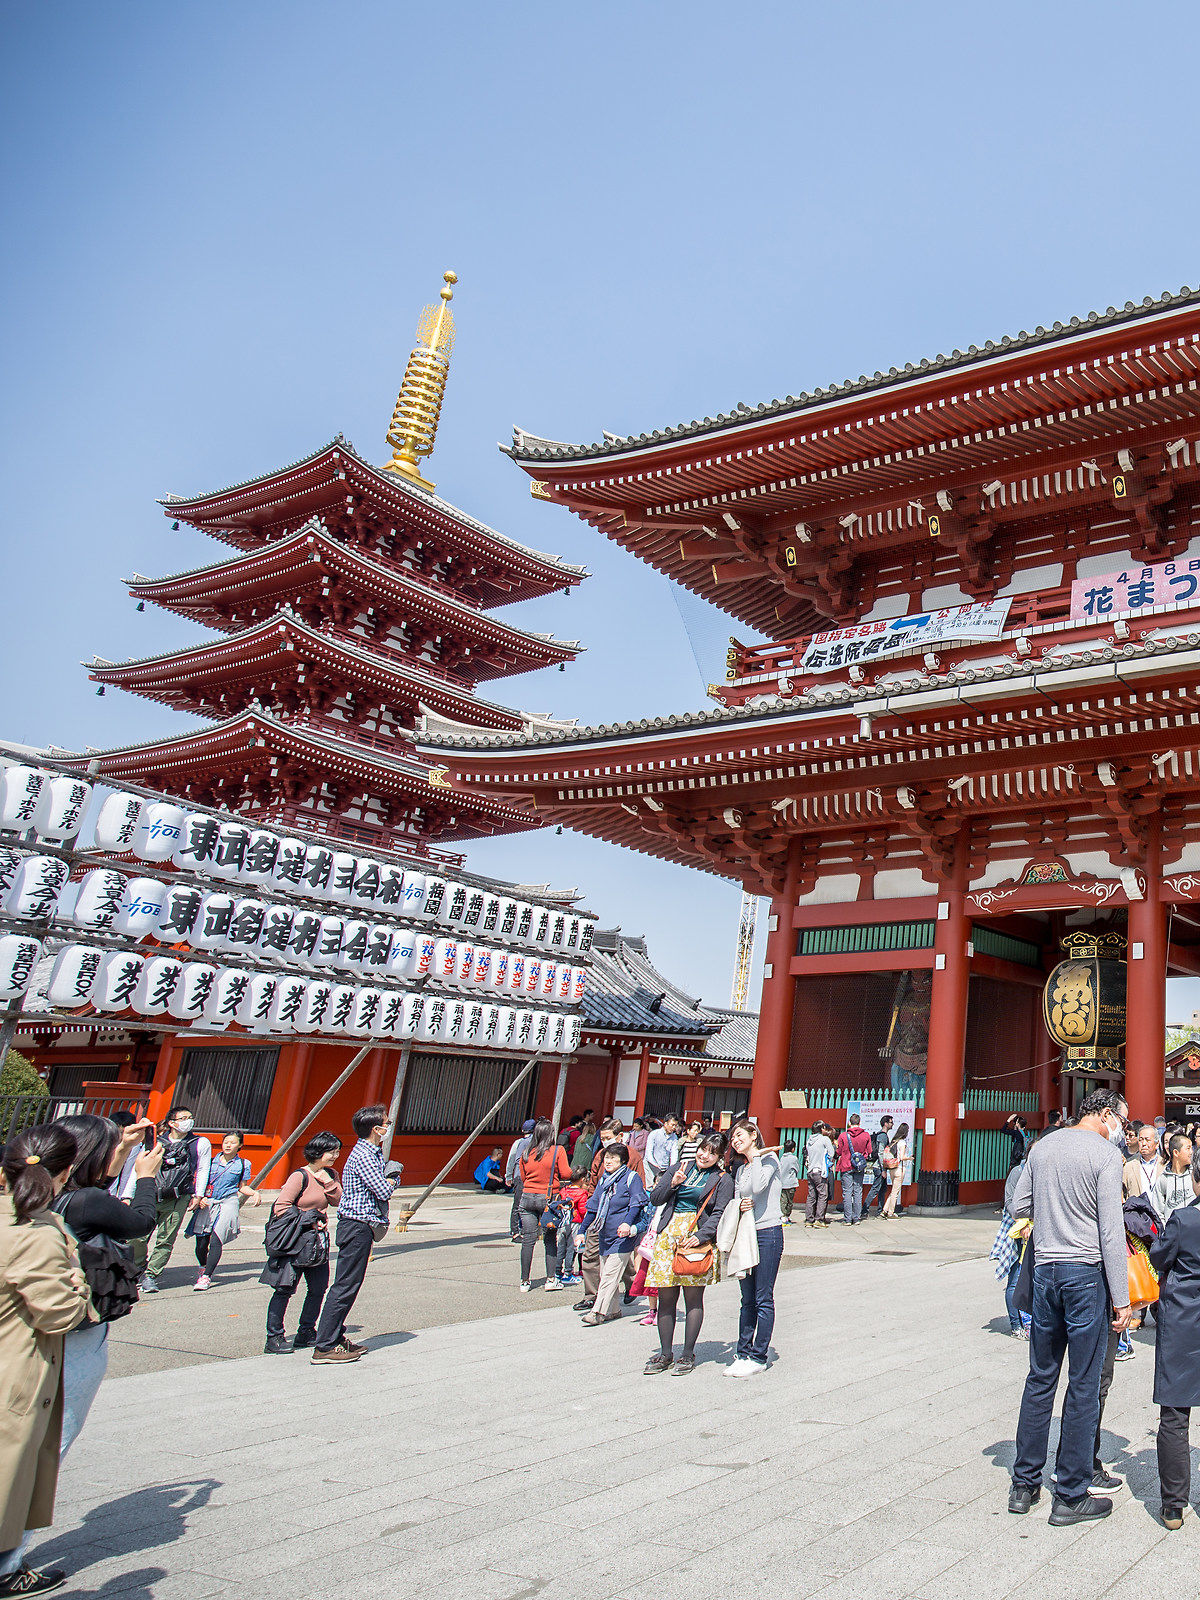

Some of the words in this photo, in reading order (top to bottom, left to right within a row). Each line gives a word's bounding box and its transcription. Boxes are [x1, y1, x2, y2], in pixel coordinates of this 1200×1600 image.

[814, 622, 887, 645] 国指定名勝
[21, 859, 69, 918] 浅草今半
[85, 872, 129, 929] 浅草今半
